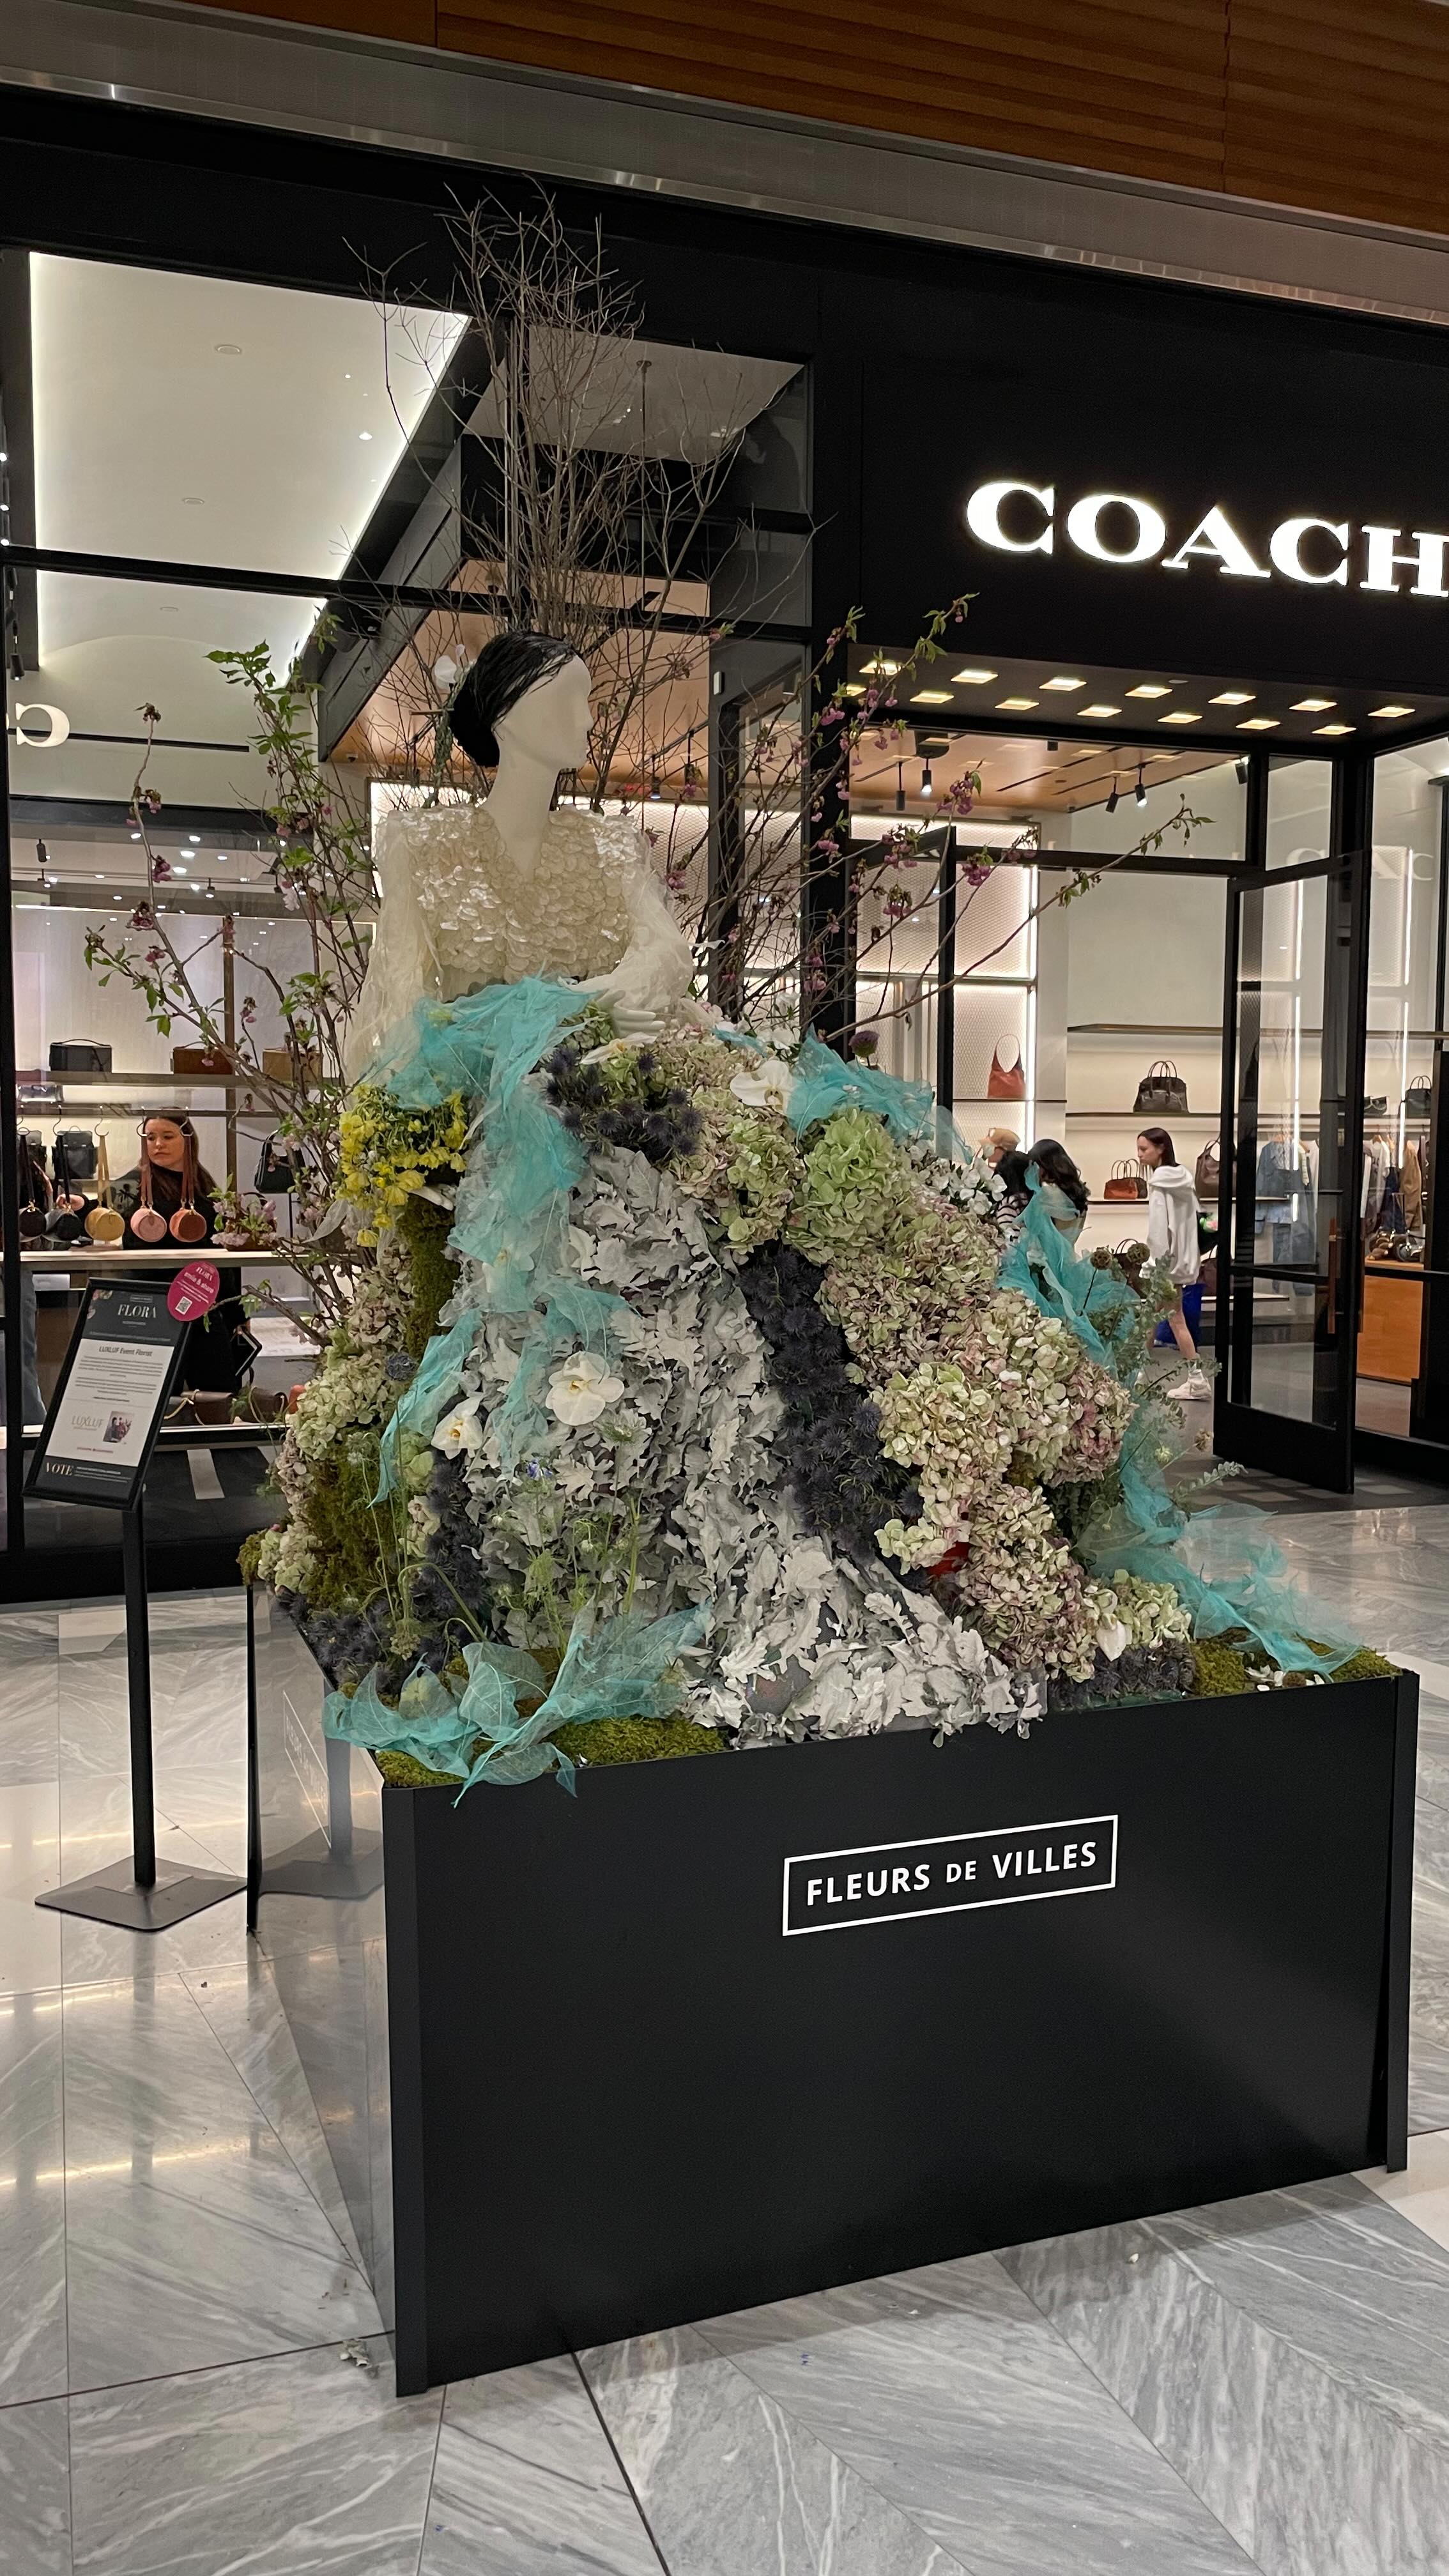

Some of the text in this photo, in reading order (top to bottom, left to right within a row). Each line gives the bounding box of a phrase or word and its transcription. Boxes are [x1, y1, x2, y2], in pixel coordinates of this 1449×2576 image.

[966, 481, 1449, 597] COACH
[117, 1303, 157, 1319] FLORA
[46, 1462, 74, 1476] VOTE
[806, 1841, 1097, 1906] FLEURS DE VILLES
